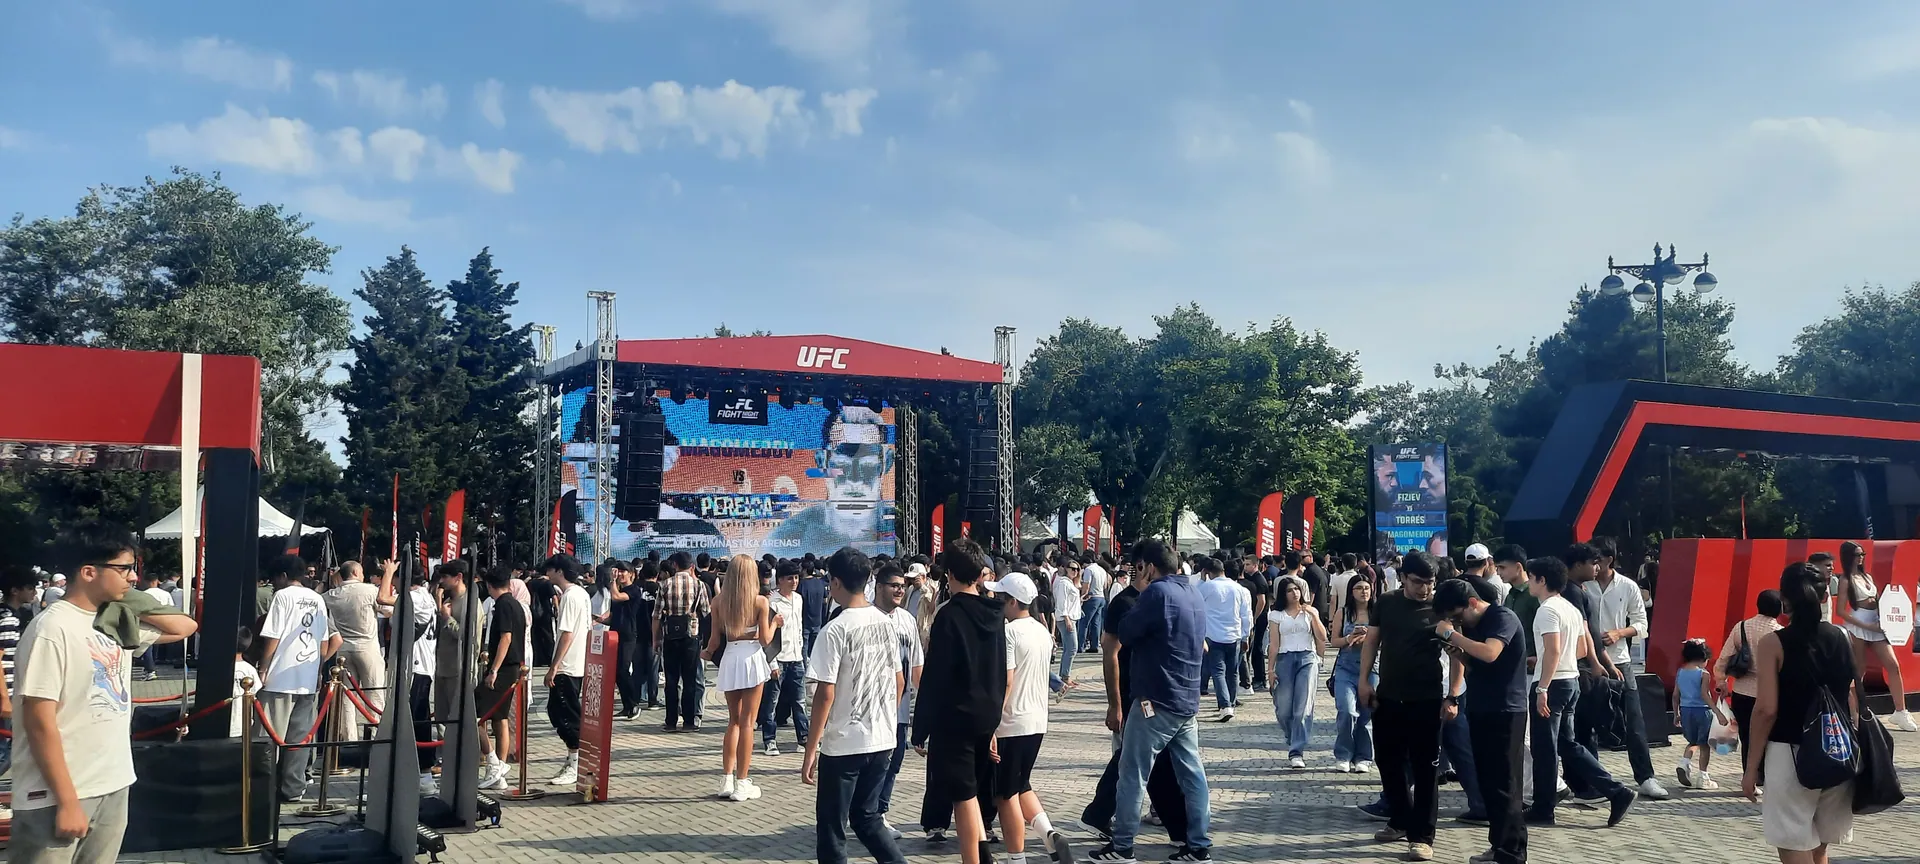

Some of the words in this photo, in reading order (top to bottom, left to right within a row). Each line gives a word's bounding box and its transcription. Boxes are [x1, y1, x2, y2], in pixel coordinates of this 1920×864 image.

[796, 345, 850, 369] UFC
[717, 410, 741, 418] FIGHT
[1399, 447, 1418, 455] UFC
[733, 470, 745, 481] VS
